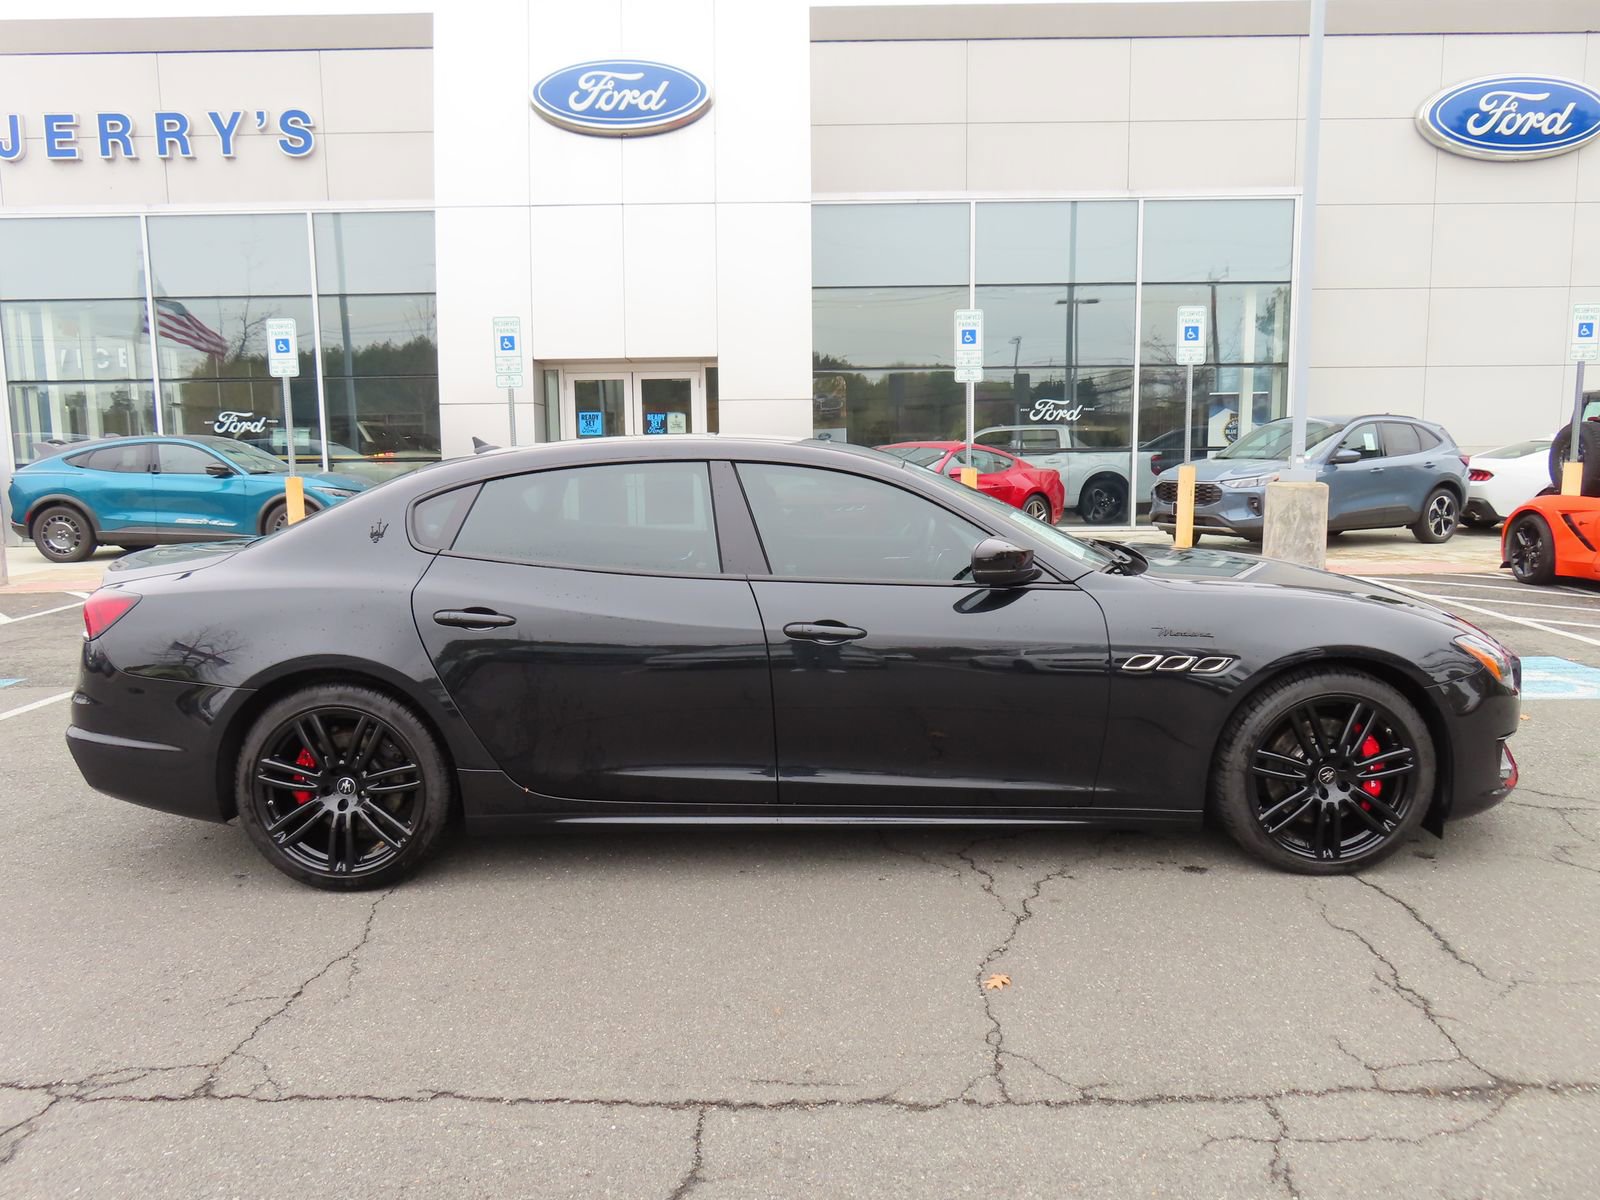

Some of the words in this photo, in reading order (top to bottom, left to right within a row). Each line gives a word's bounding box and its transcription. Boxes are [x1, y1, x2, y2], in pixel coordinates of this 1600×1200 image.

[568, 70, 670, 112] Ford
[1466, 90, 1577, 136] Ford
[0, 109, 316, 161] JERRY'S
[214, 411, 266, 434] Ford
[1029, 398, 1083, 422] Ford
